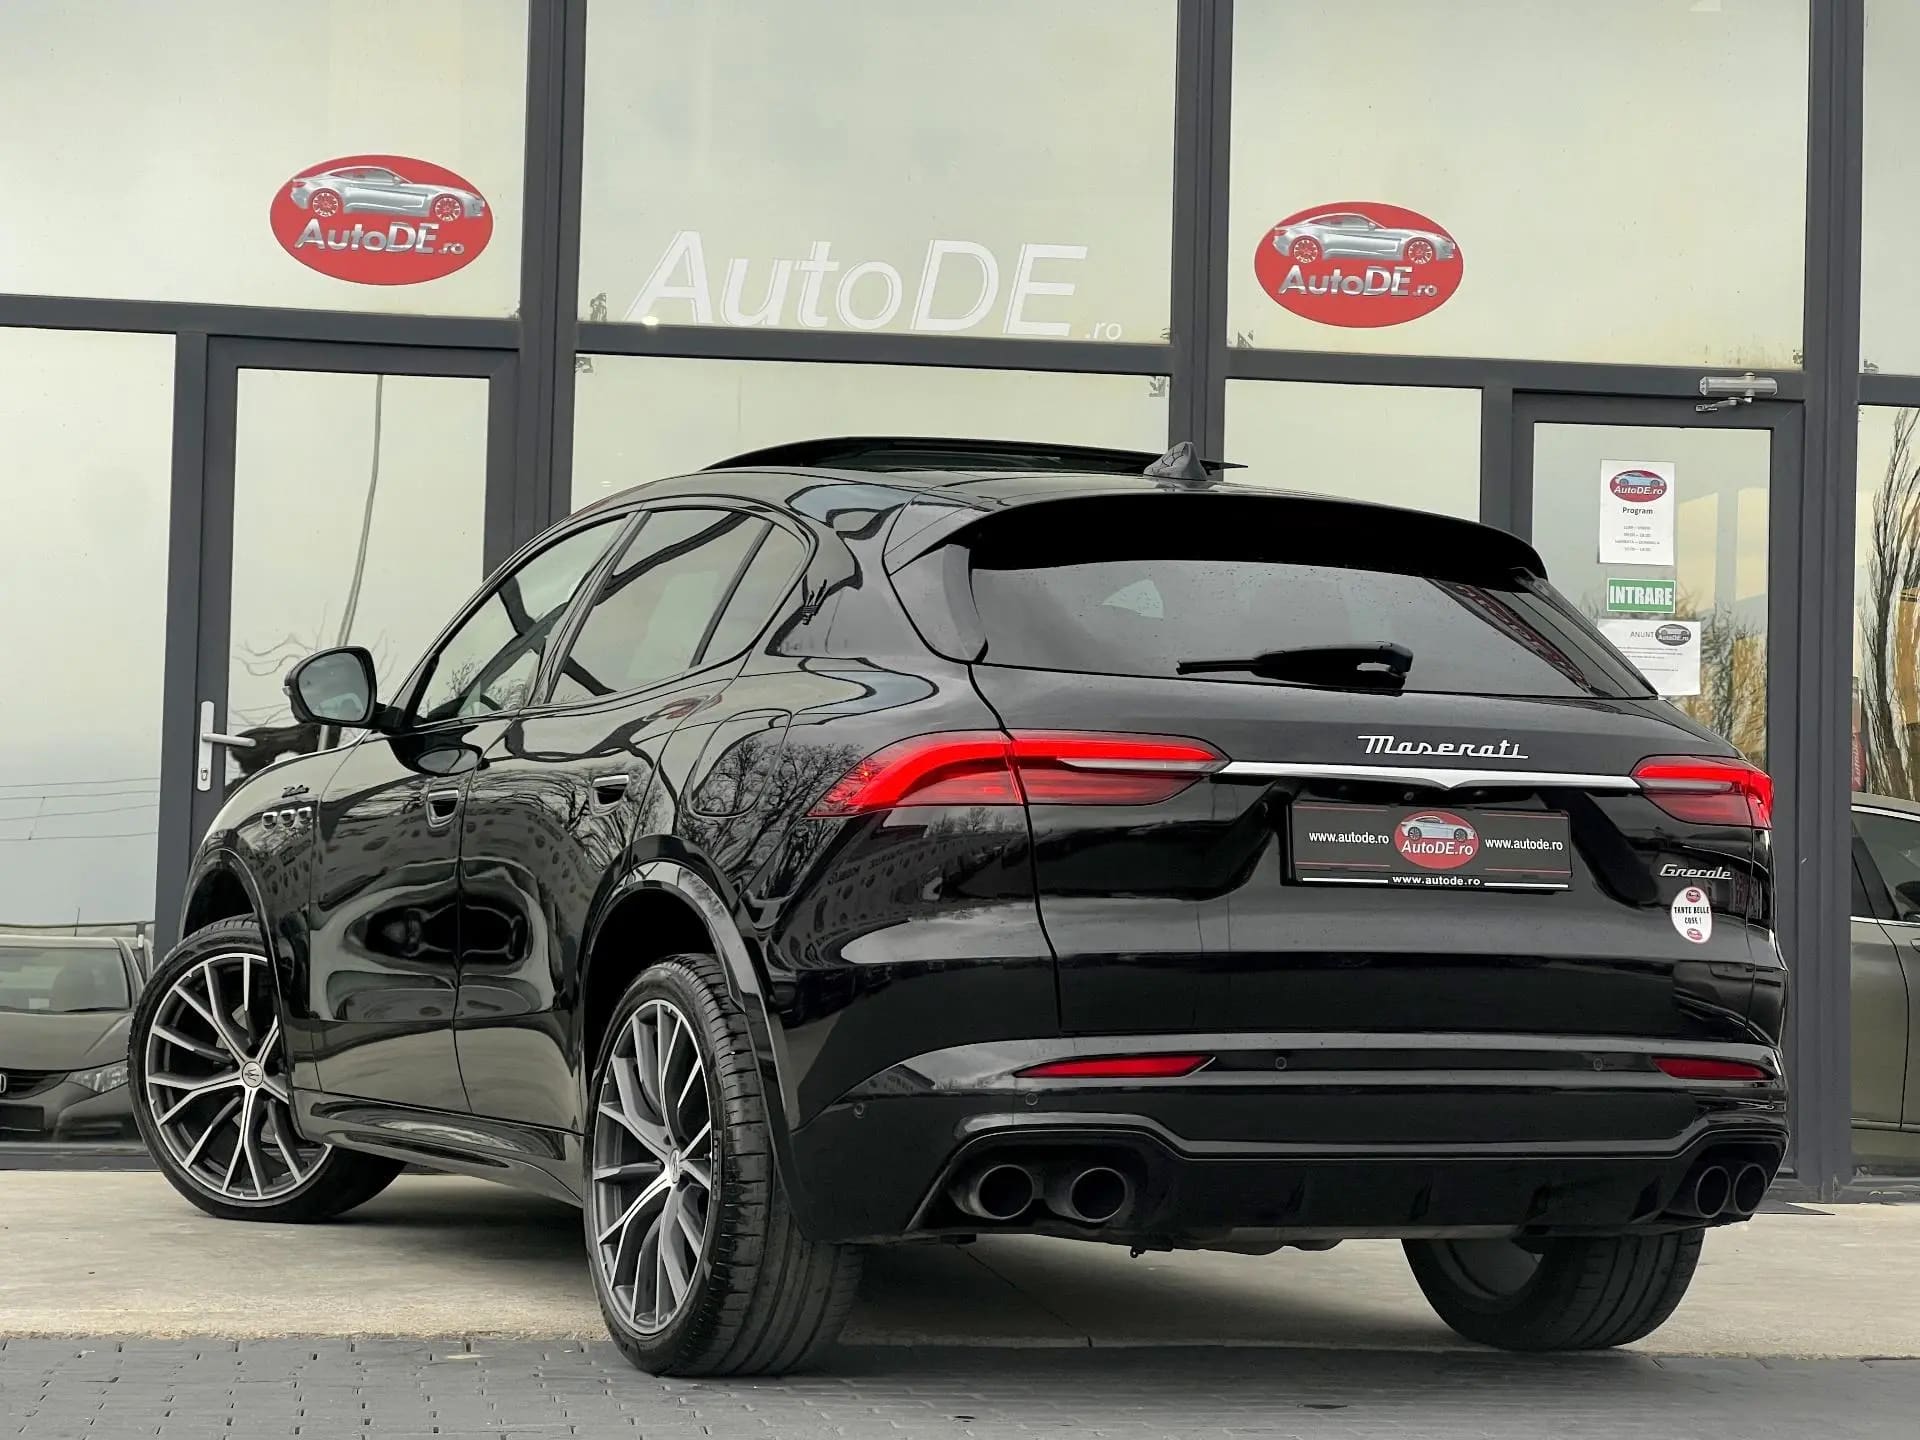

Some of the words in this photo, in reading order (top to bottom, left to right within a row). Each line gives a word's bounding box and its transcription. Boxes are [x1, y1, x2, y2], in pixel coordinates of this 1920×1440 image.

[1614, 485, 1663, 495] AutoDE.ro
[1622, 506, 1654, 516] Program
[1609, 585, 1673, 606] INTRARE
[1358, 735, 1529, 760] Maserati
[1309, 831, 1390, 845] www.autode.ro
[1485, 837, 1564, 851] www.autode.ro
[1401, 839, 1474, 856] AutoDE.ro
[1660, 863, 1733, 880] Grecale
[1392, 875, 1481, 887] www.autode.ro
[1673, 906, 1692, 914] TANTE
[1693, 906, 1710, 914] BELLE
